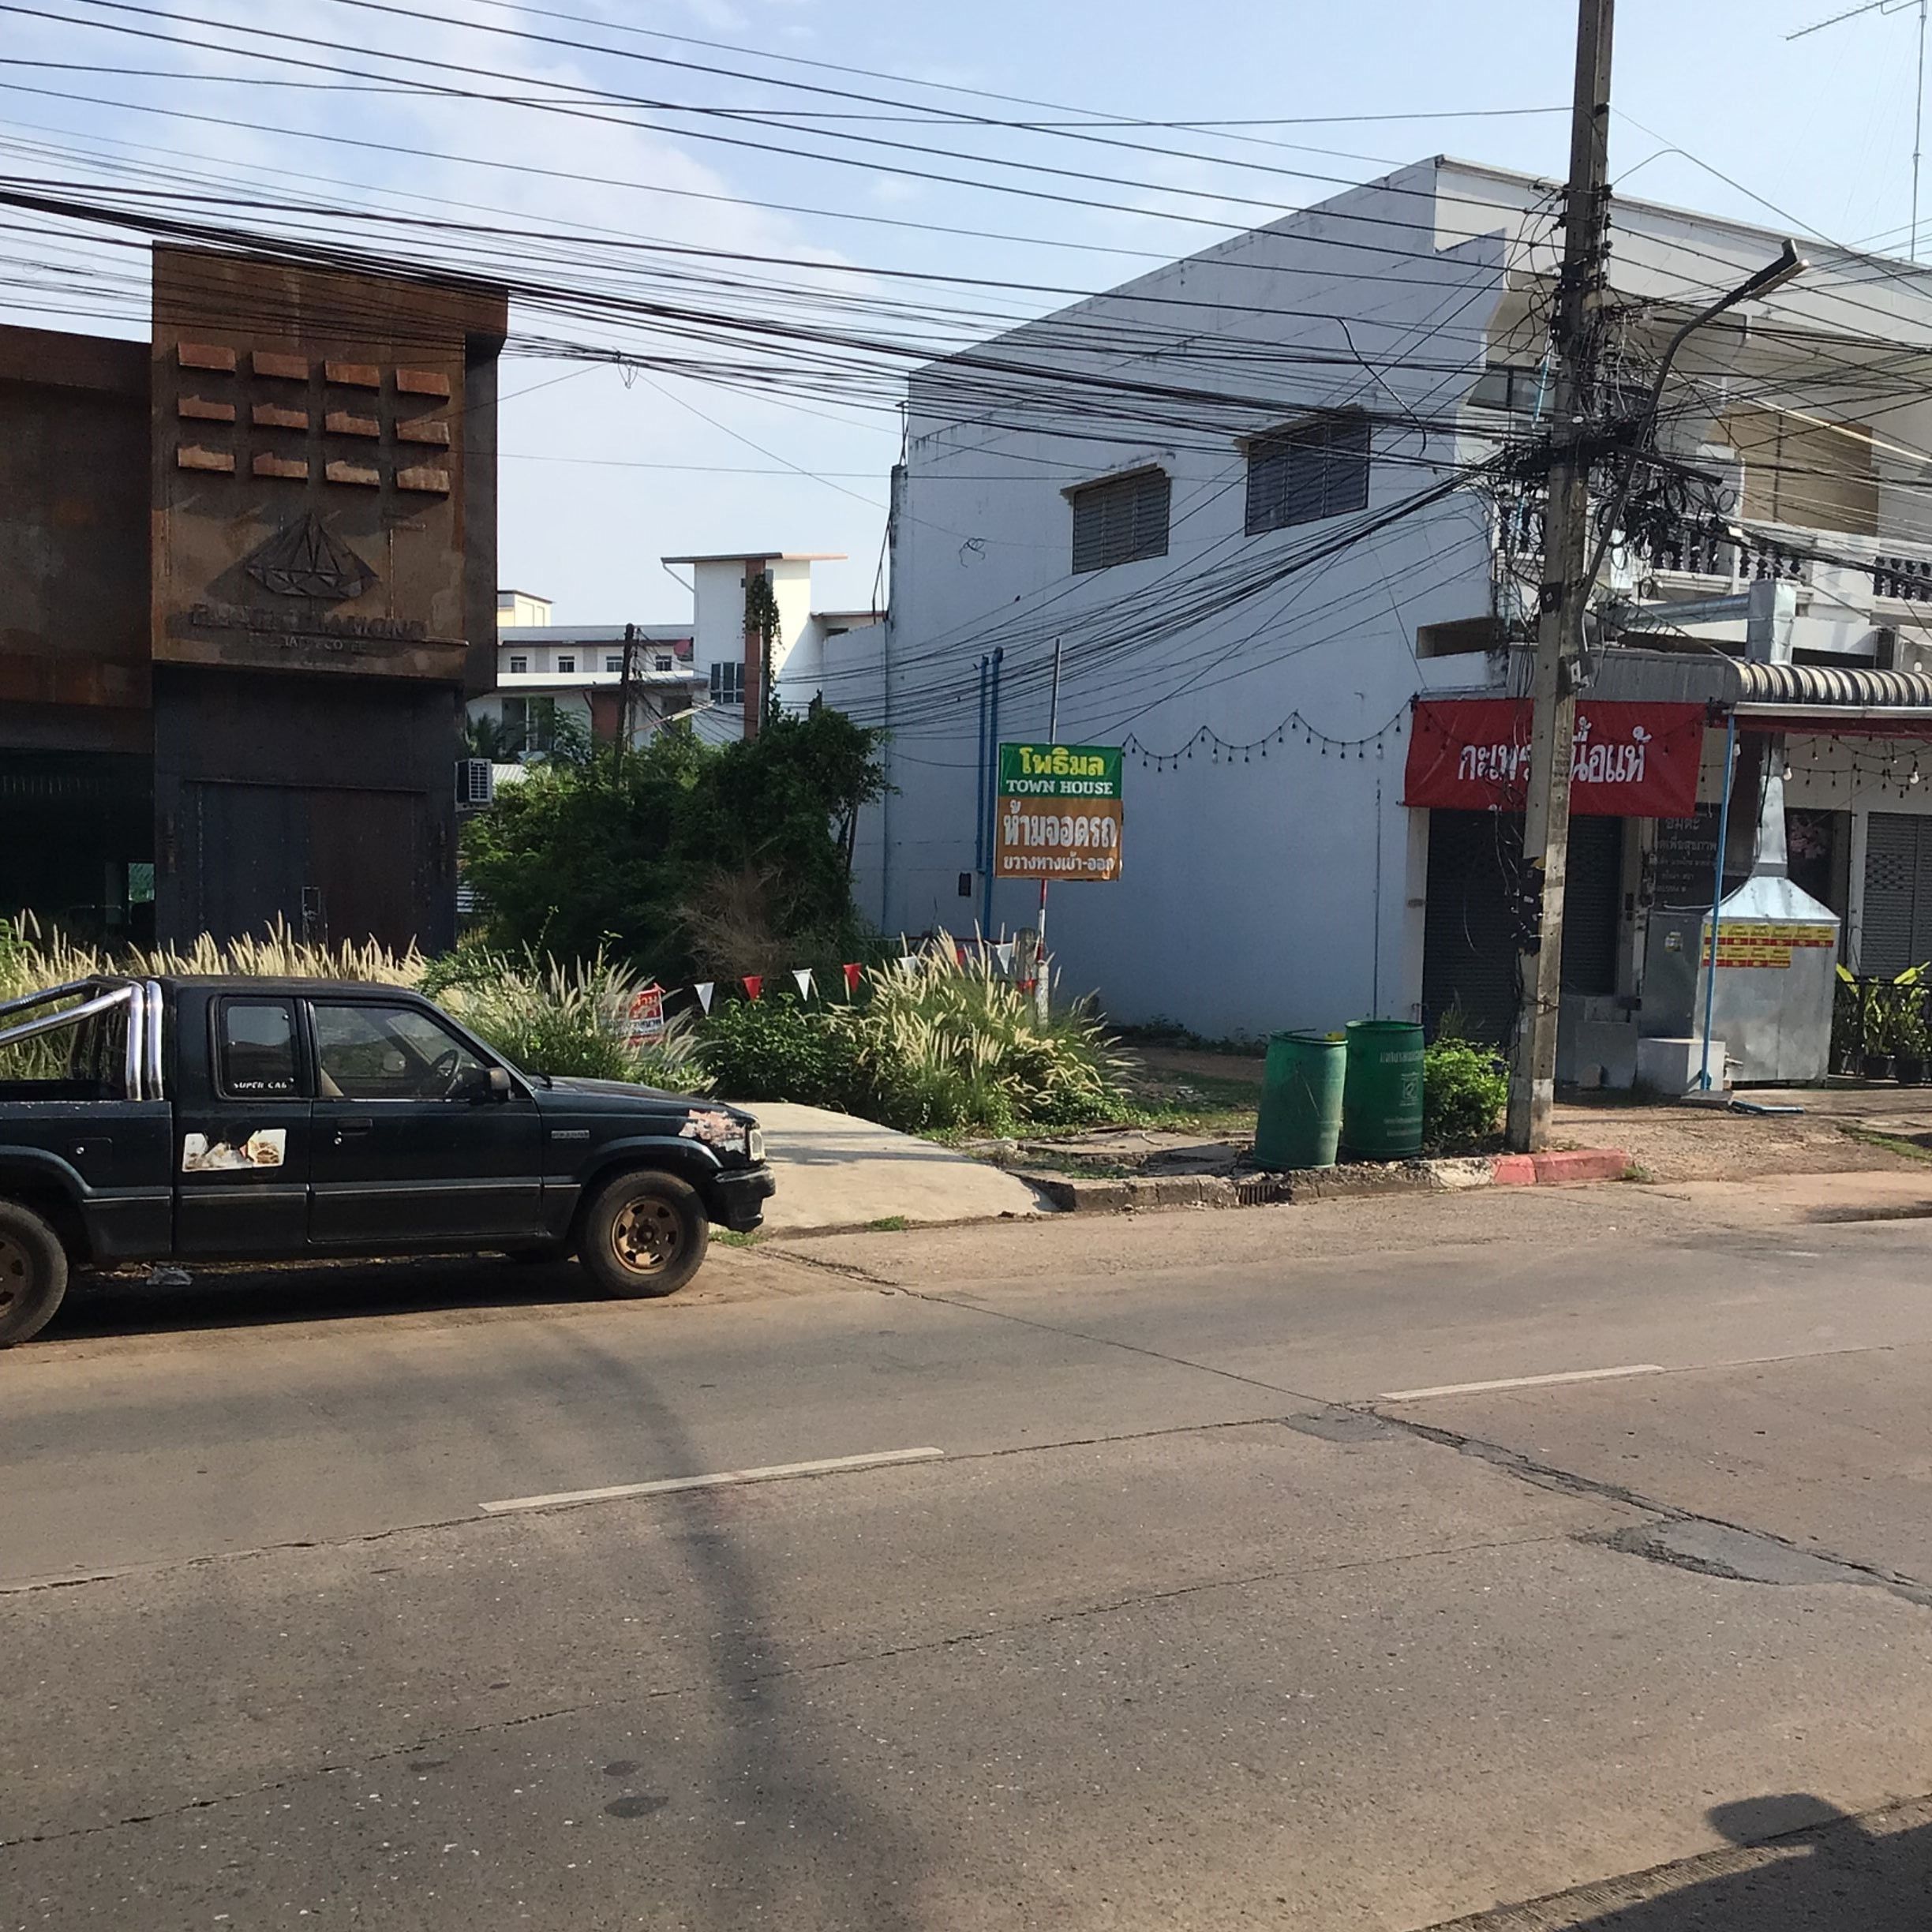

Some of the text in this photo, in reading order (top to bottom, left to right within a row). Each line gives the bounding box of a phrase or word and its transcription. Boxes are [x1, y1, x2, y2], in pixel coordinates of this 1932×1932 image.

[1005, 779, 1114, 795] TOWN HOUSE
[1003, 799, 1118, 848] ห้ามจอดรถ
[1003, 851, 1116, 871] ขวางทางเข้า-ออก
